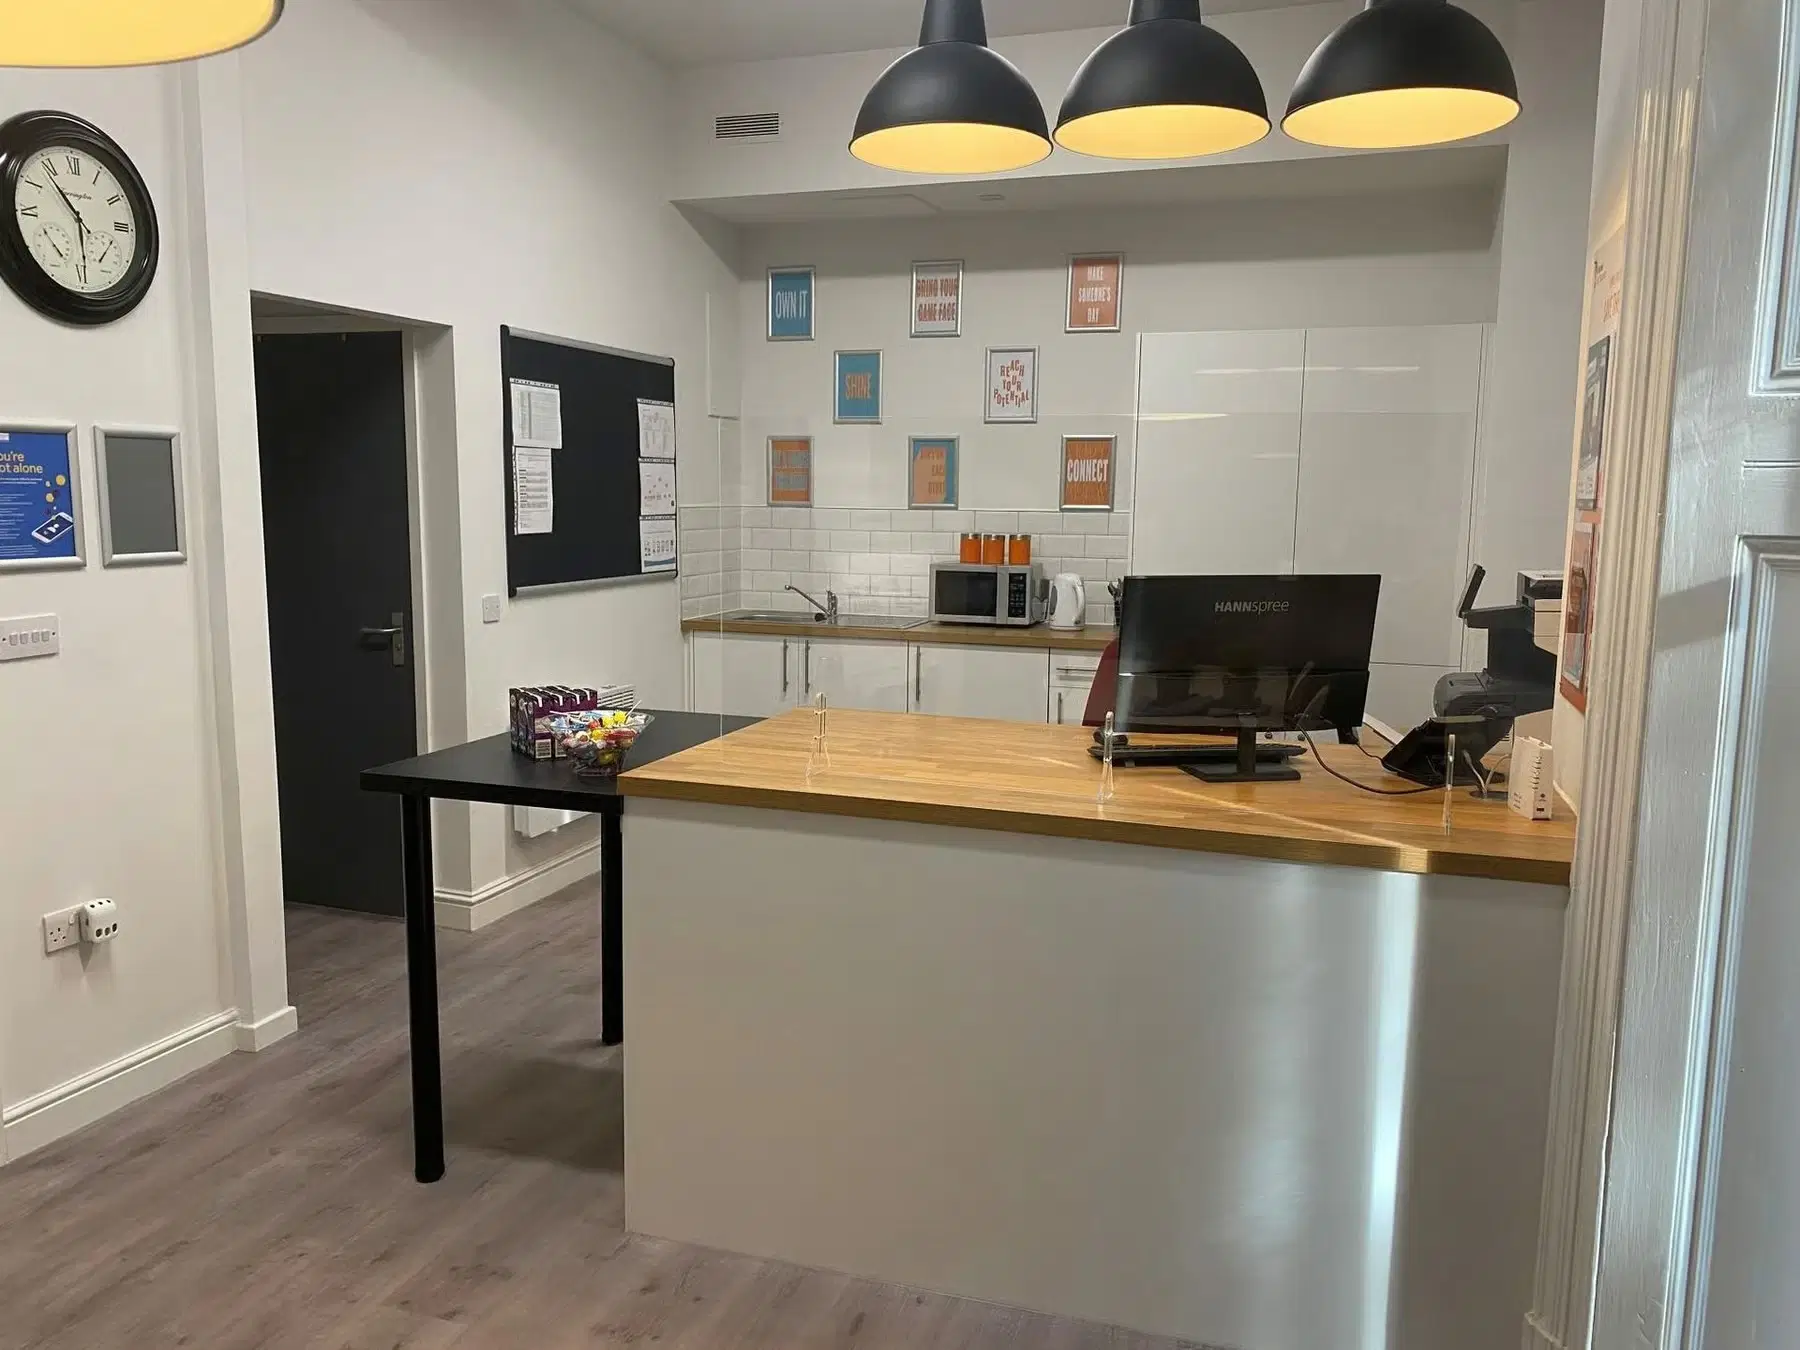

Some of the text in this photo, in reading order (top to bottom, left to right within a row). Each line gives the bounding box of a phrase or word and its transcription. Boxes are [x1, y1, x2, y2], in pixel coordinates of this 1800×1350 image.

[775, 290, 808, 319] OWN IT
[1000, 360, 1025, 377] REACH
[844, 372, 872, 400] SHINE
[1002, 375, 1022, 392] YOUR
[993, 389, 1029, 408] POTENTIAL
[13, 463, 44, 474] alone
[1067, 459, 1109, 482] CONNECT
[1214, 601, 1290, 615] HANNspree
